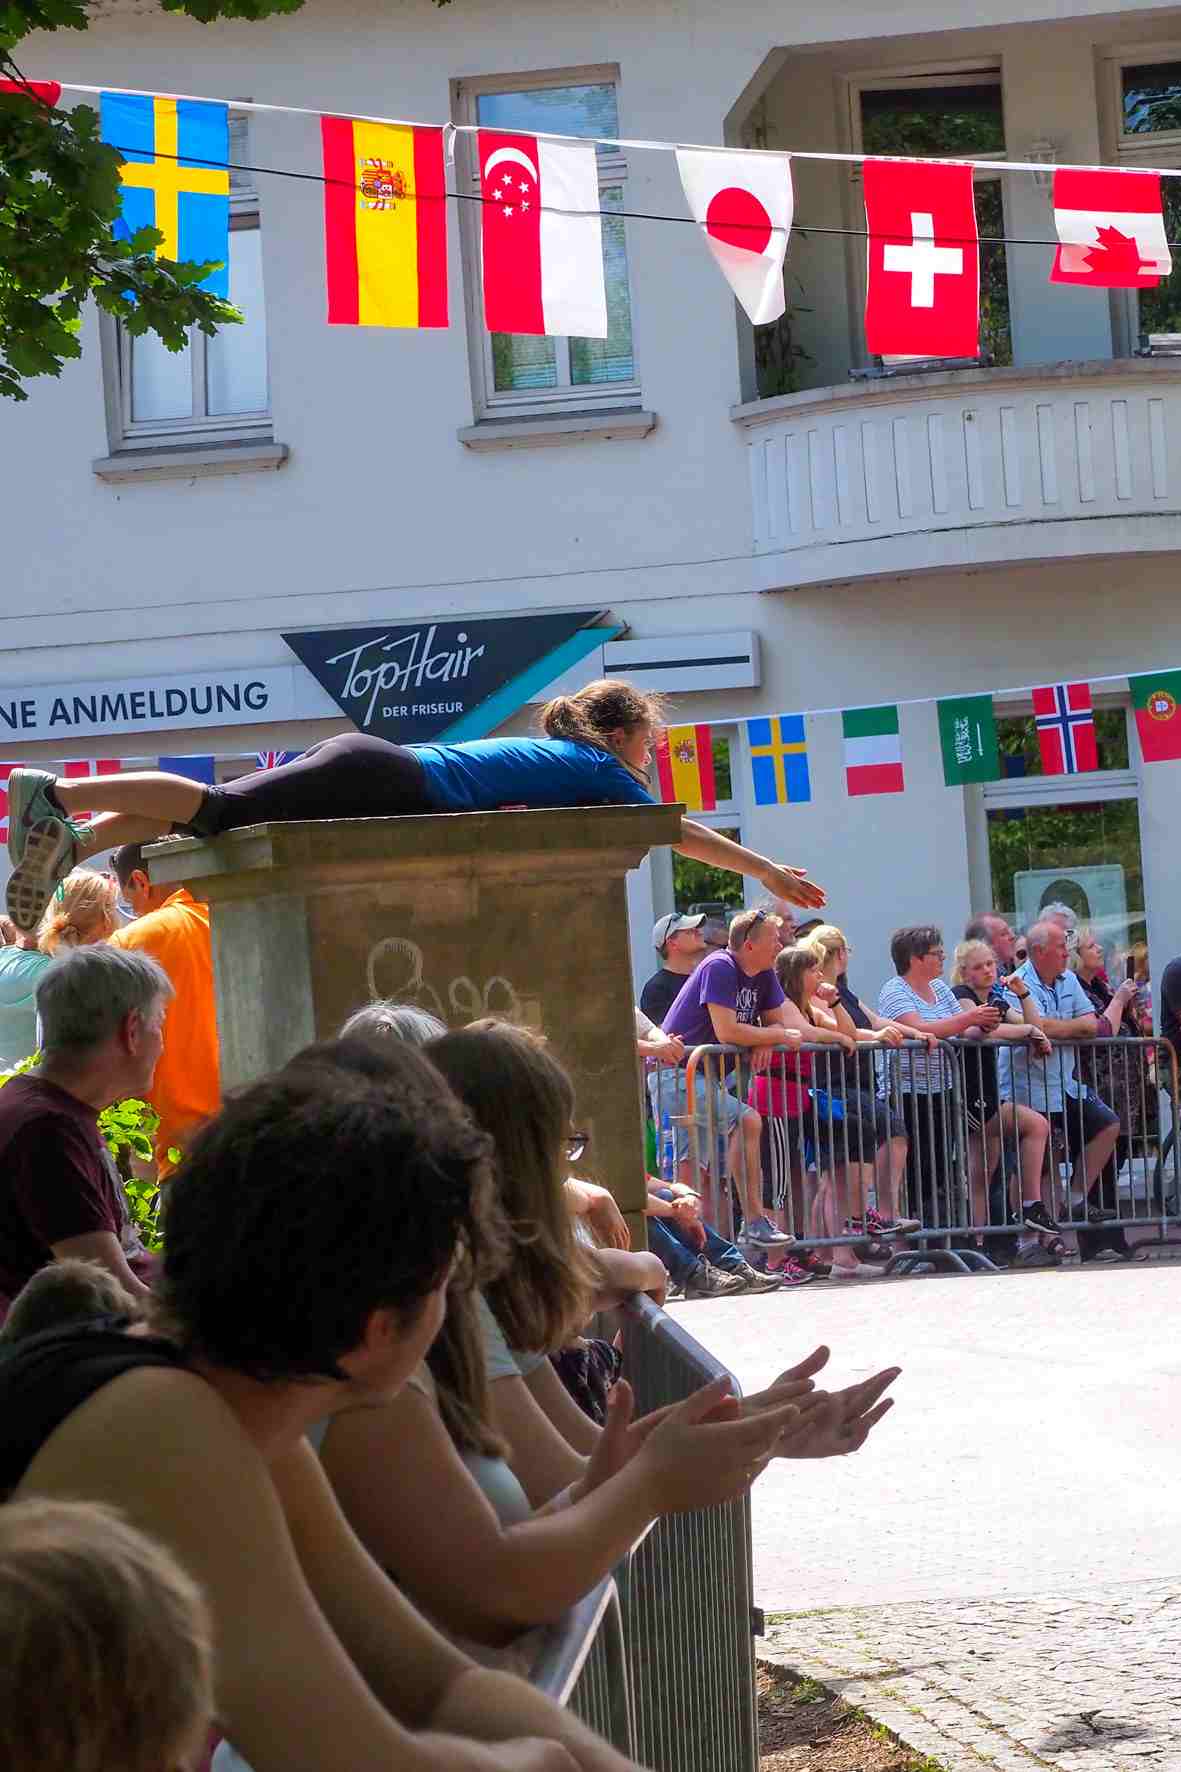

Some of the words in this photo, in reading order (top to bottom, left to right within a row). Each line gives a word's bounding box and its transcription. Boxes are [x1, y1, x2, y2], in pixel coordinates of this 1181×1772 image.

[325, 624, 485, 727] TopHair
[48, 681, 269, 726] ANMELDUNG
[382, 705, 408, 718] DER
[411, 702, 464, 716] FRISEUR
